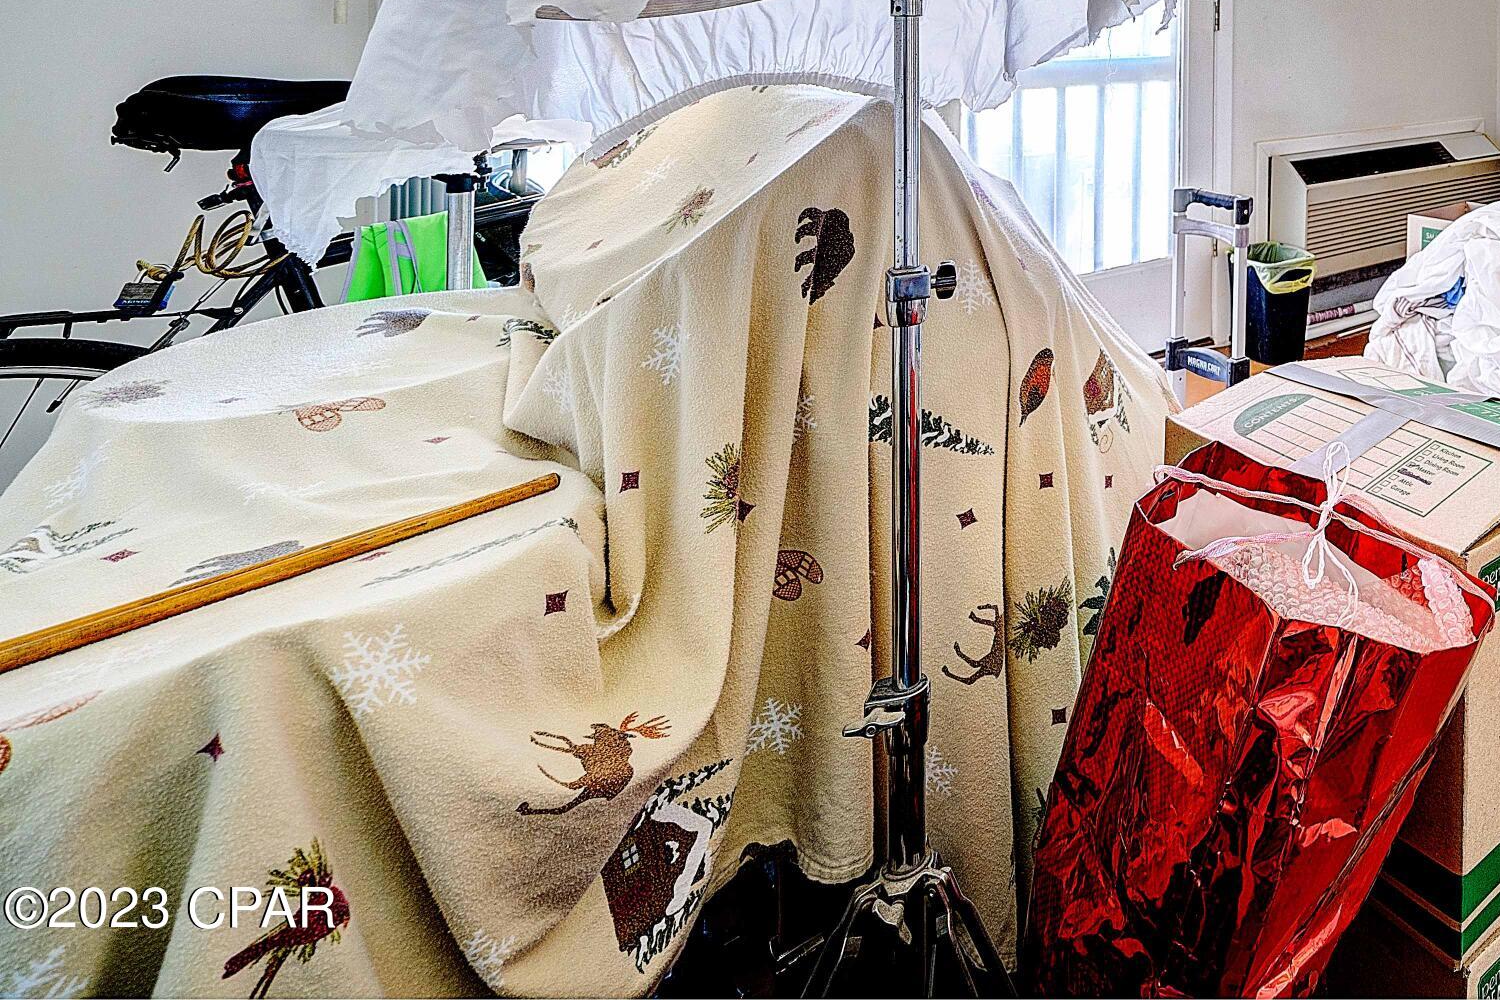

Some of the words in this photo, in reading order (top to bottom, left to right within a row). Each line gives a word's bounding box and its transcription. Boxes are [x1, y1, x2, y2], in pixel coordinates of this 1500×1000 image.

[1187, 355, 1207, 371] MAGNA
[1207, 362, 1220, 376] CART
[1449, 460, 1466, 471] Room
[1442, 466, 1460, 477] Room
[1390, 484, 1411, 496] Garage
